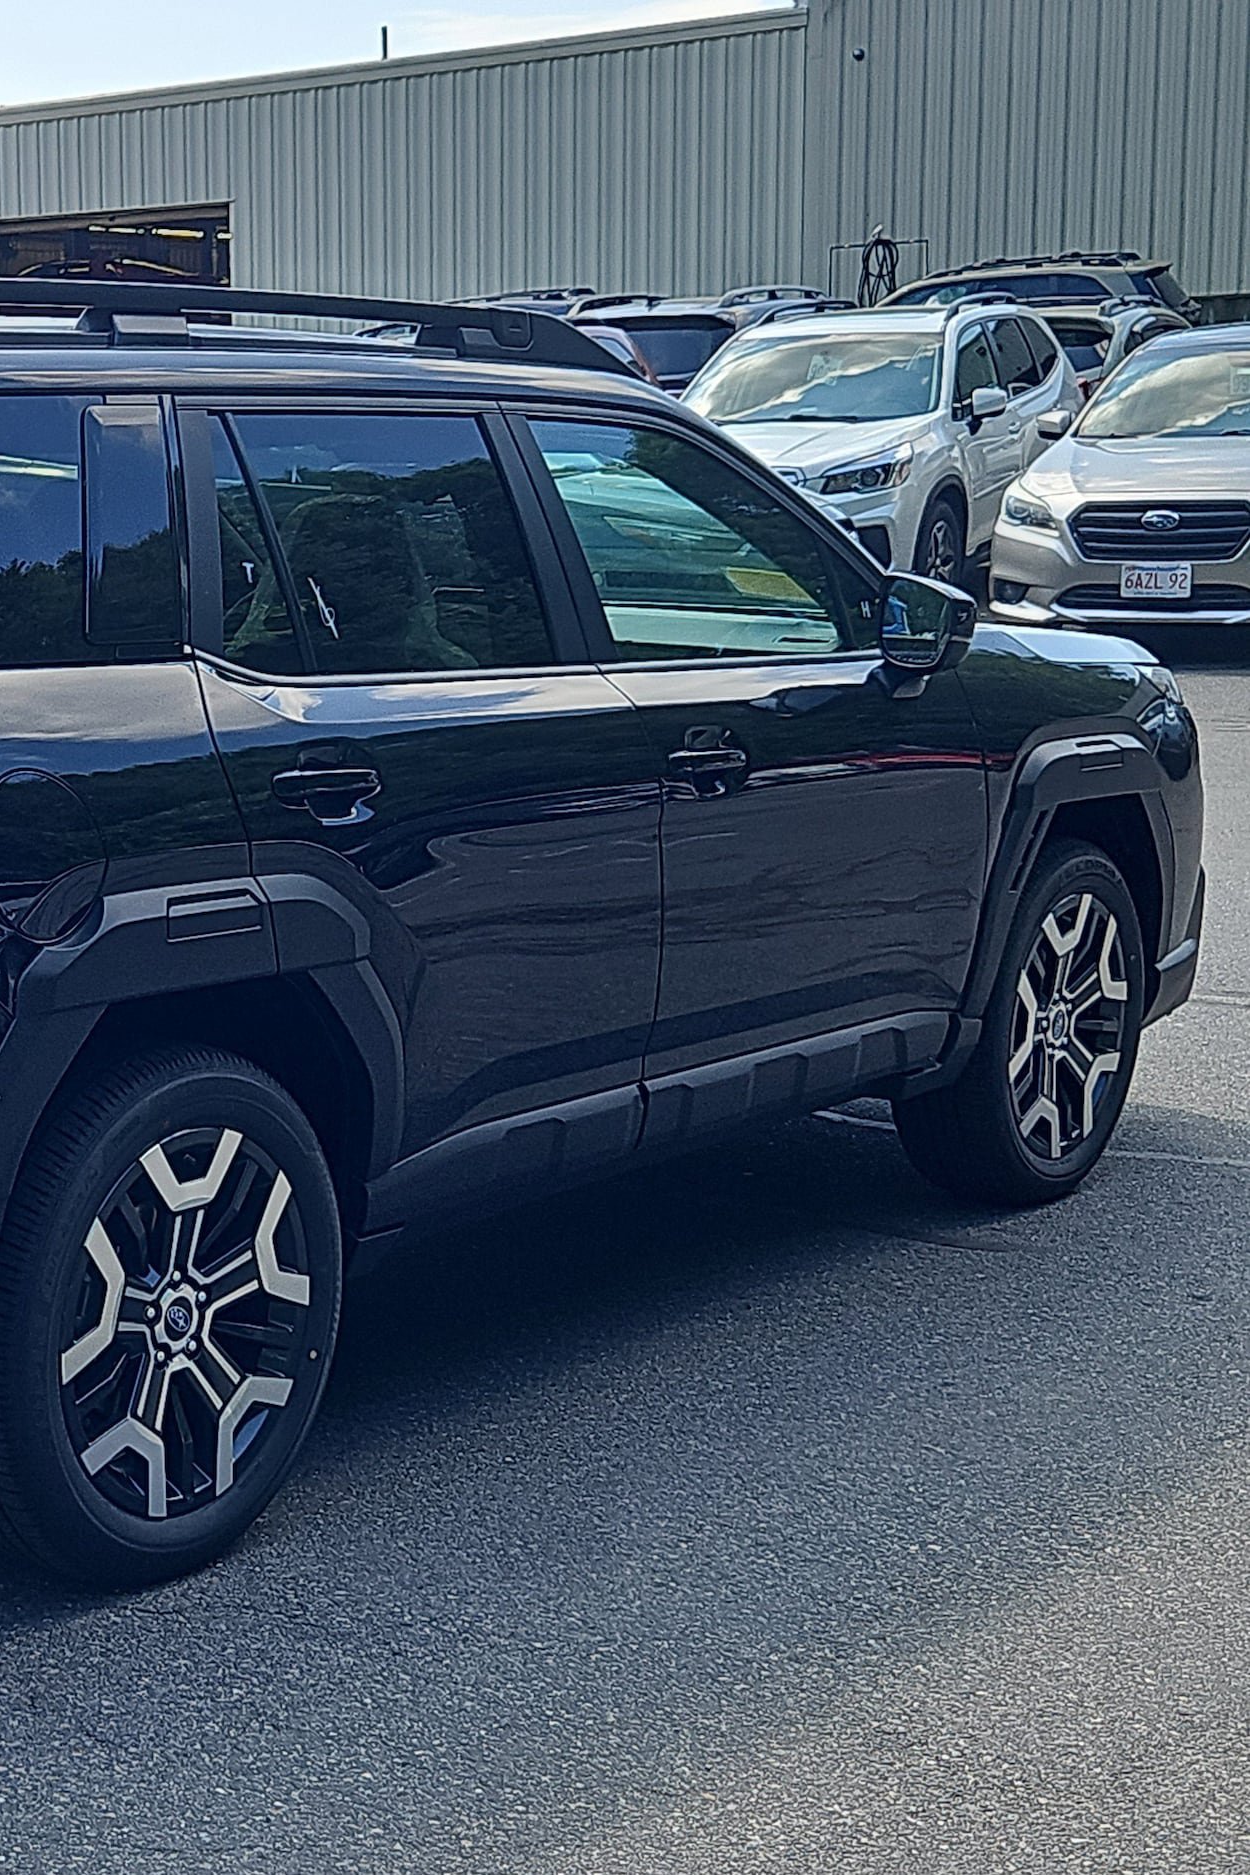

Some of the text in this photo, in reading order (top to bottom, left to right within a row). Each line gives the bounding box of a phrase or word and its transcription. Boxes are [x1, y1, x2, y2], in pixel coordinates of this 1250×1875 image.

[241, 562, 254, 583] T
[1125, 572, 1188, 590] 6AZL 92
[860, 600, 872, 618] H
